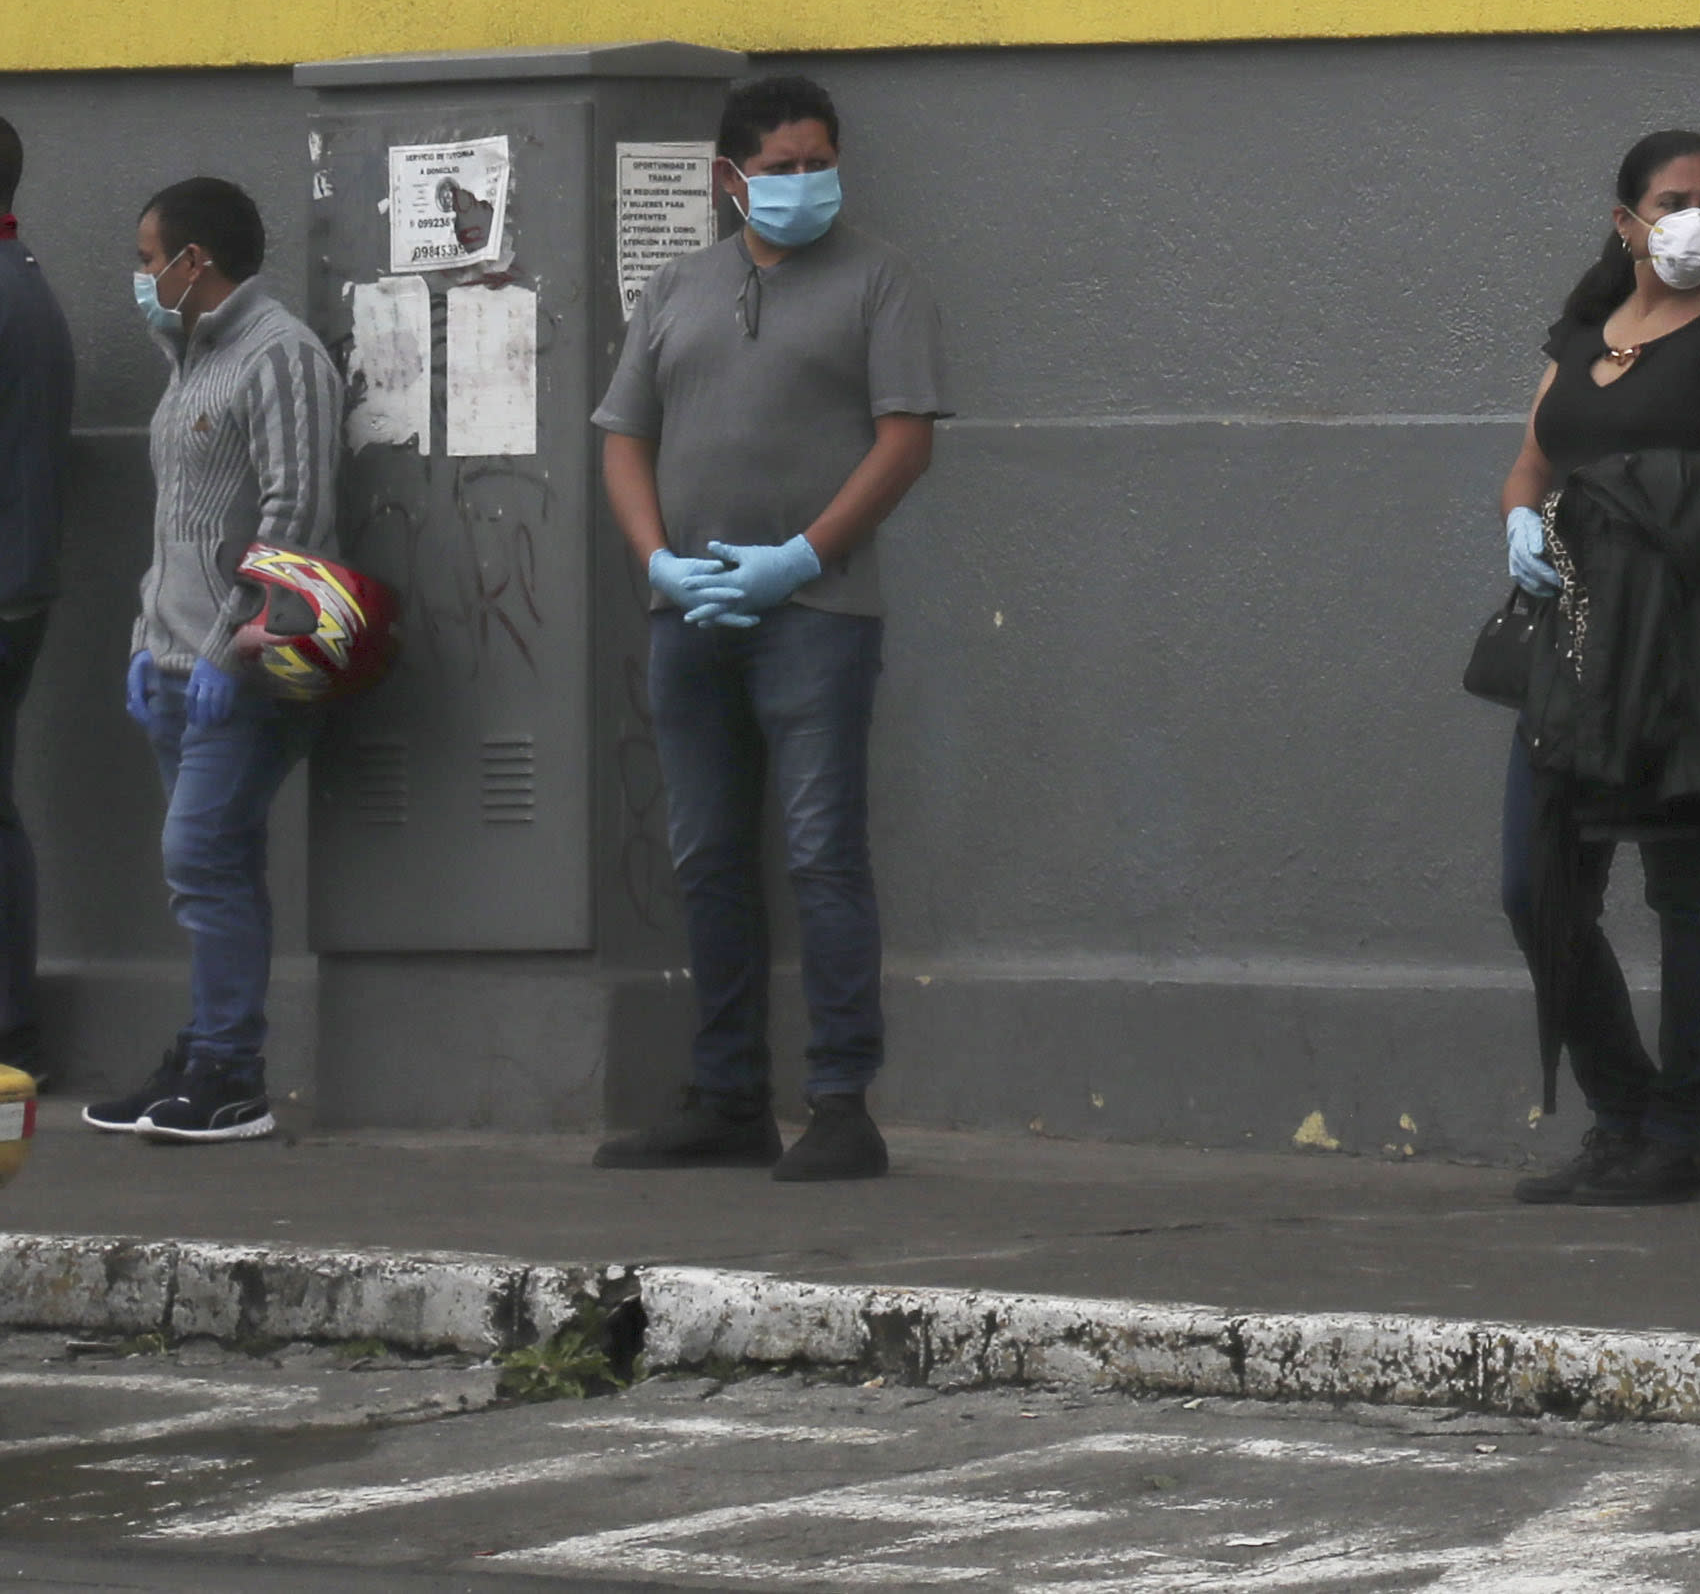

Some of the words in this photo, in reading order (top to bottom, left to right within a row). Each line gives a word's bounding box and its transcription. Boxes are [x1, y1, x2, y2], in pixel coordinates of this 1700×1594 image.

[436, 152, 445, 161] DE
[633, 161, 685, 170] OPORTUNIDAD
[687, 162, 697, 170] DE
[648, 173, 682, 182] TRABAJO
[672, 189, 707, 197] HOMBRES
[630, 201, 663, 209] MUJERES
[665, 201, 685, 209] PARA
[622, 213, 667, 222] DIFERENTES
